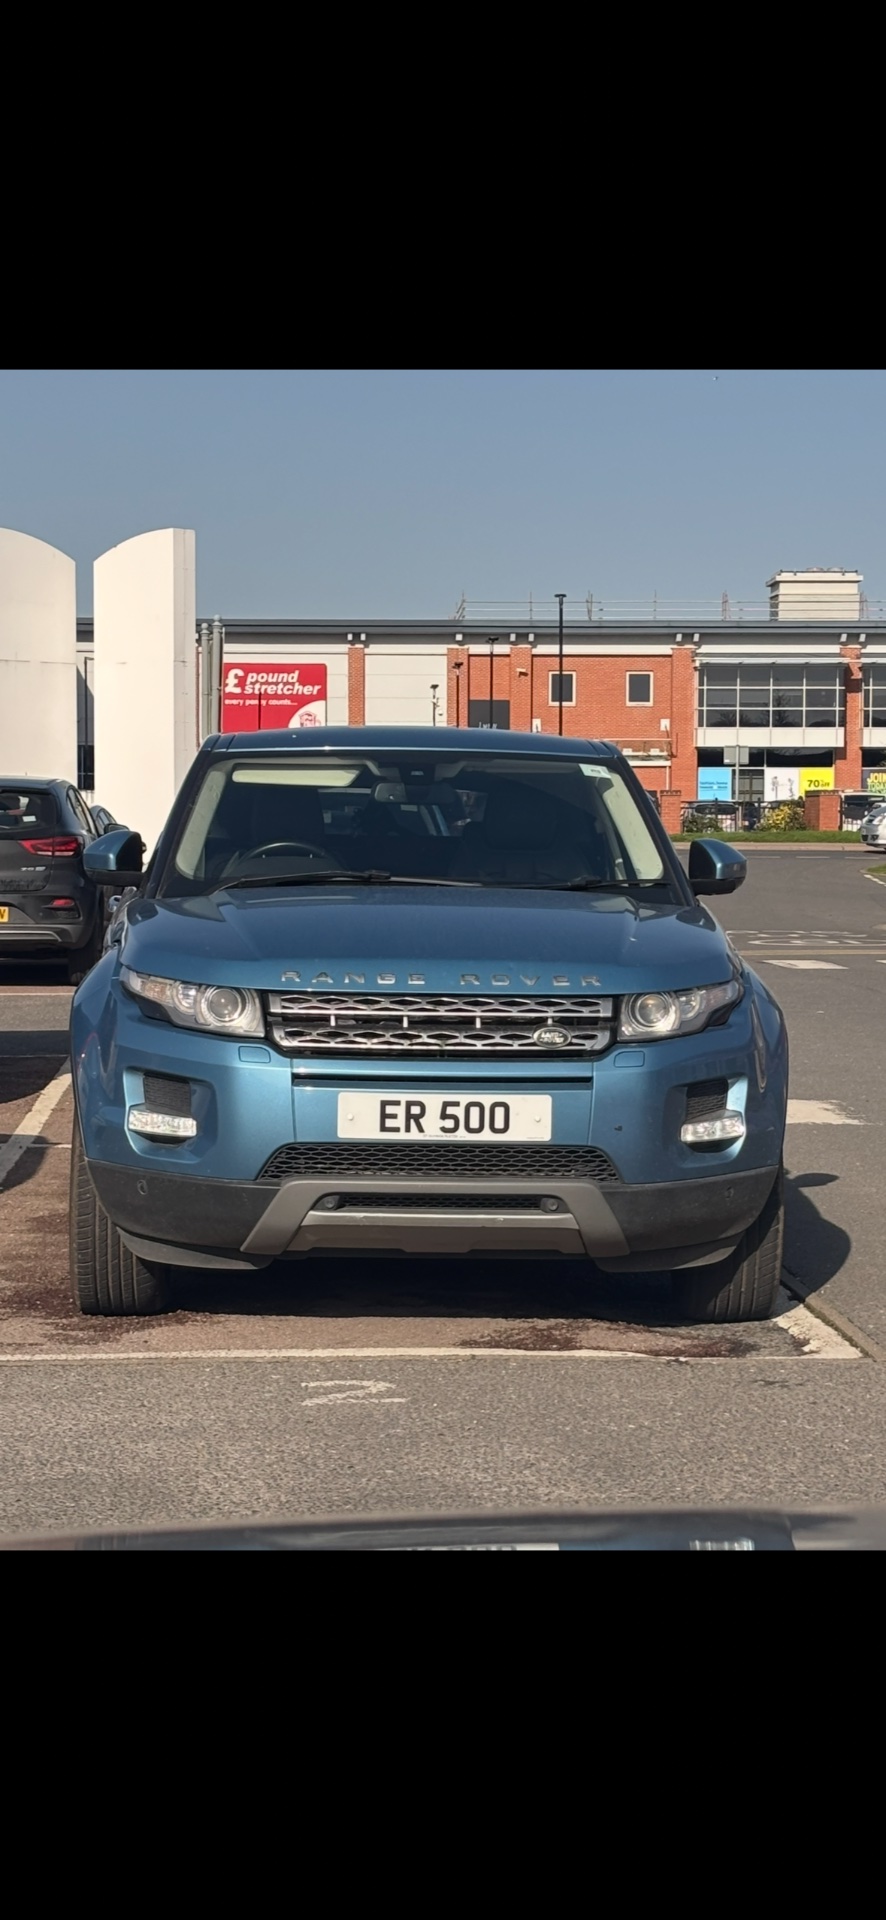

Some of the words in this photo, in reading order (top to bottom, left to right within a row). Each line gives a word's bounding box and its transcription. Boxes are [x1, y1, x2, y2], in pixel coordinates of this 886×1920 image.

[245, 670, 300, 685] pound
[244, 682, 322, 695] stretcher
[280, 970, 426, 985] RANGE
[459, 973, 602, 987] ROVER
[379, 1099, 427, 1134] ER
[439, 1100, 510, 1134] 500
